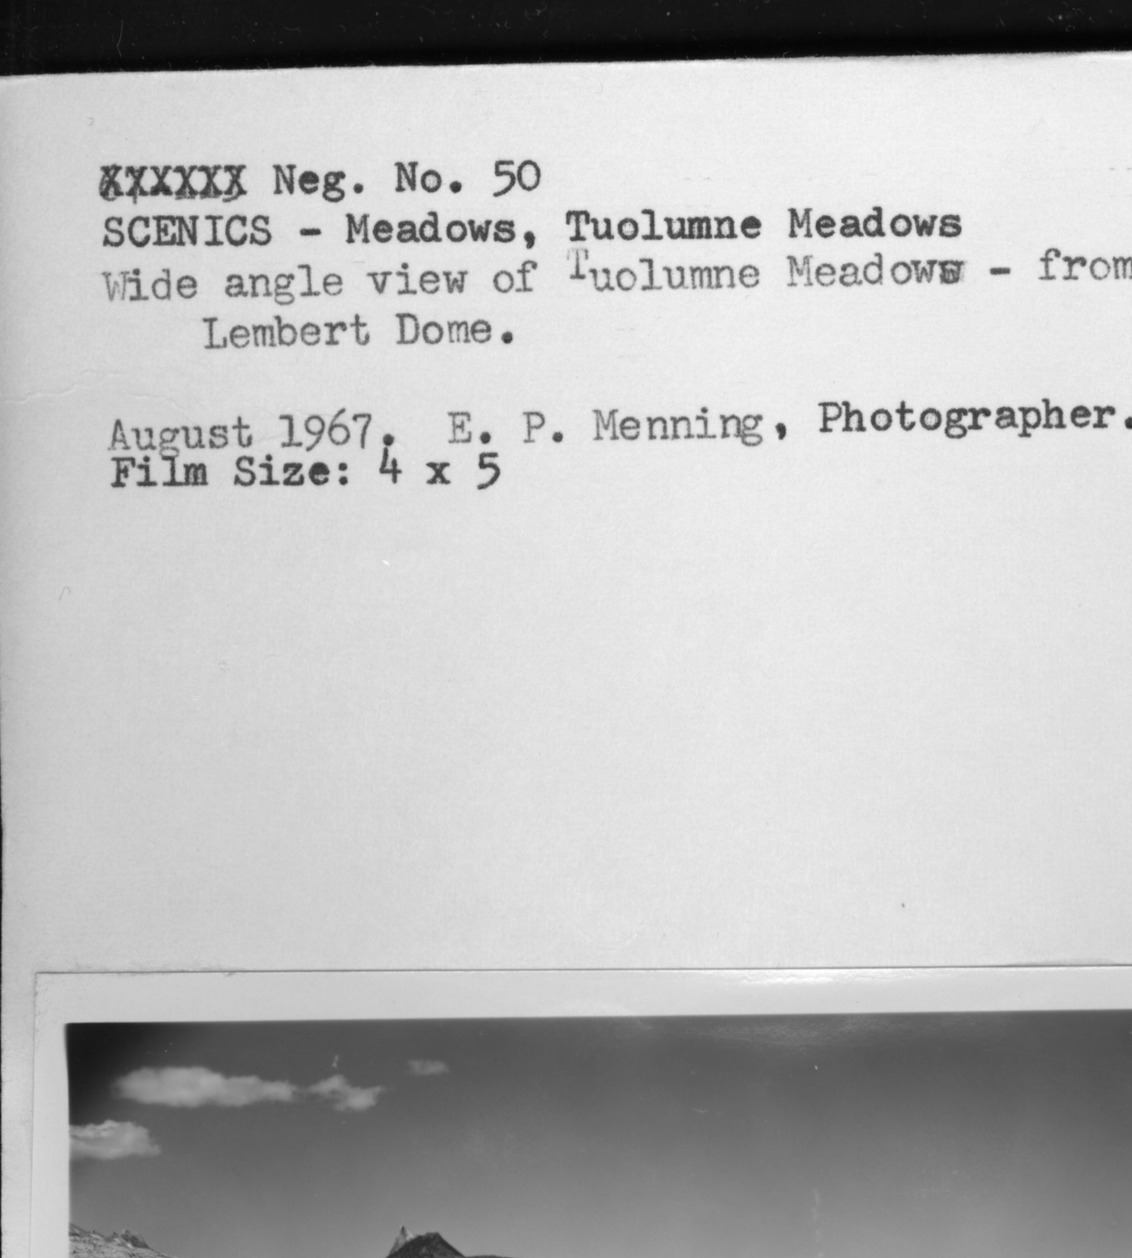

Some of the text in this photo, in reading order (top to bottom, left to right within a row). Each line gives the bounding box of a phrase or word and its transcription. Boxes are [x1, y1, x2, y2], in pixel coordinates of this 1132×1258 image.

[273, 164, 363, 203] Neg.
[394, 161, 462, 194] No.
[493, 159, 541, 198] 50
[103, 214, 272, 248] SCENICS
[346, 210, 536, 248] Meadows,
[566, 209, 762, 242] Tuolumne
[788, 206, 962, 239] Meadows
[102, 268, 197, 301] Wide
[225, 263, 343, 305] angle
[366, 262, 468, 295] view
[493, 260, 538, 294] of
[570, 248, 760, 292] Tuolumne
[202, 312, 513, 350] Lembert Dome.
[108, 416, 253, 456] August
[278, 407, 395, 453] 1967.
[448, 411, 491, 445] E.
[523, 411, 563, 443] P.
[593, 407, 787, 447] Menning,
[111, 446, 501, 490] Film Size: 4 x 5
